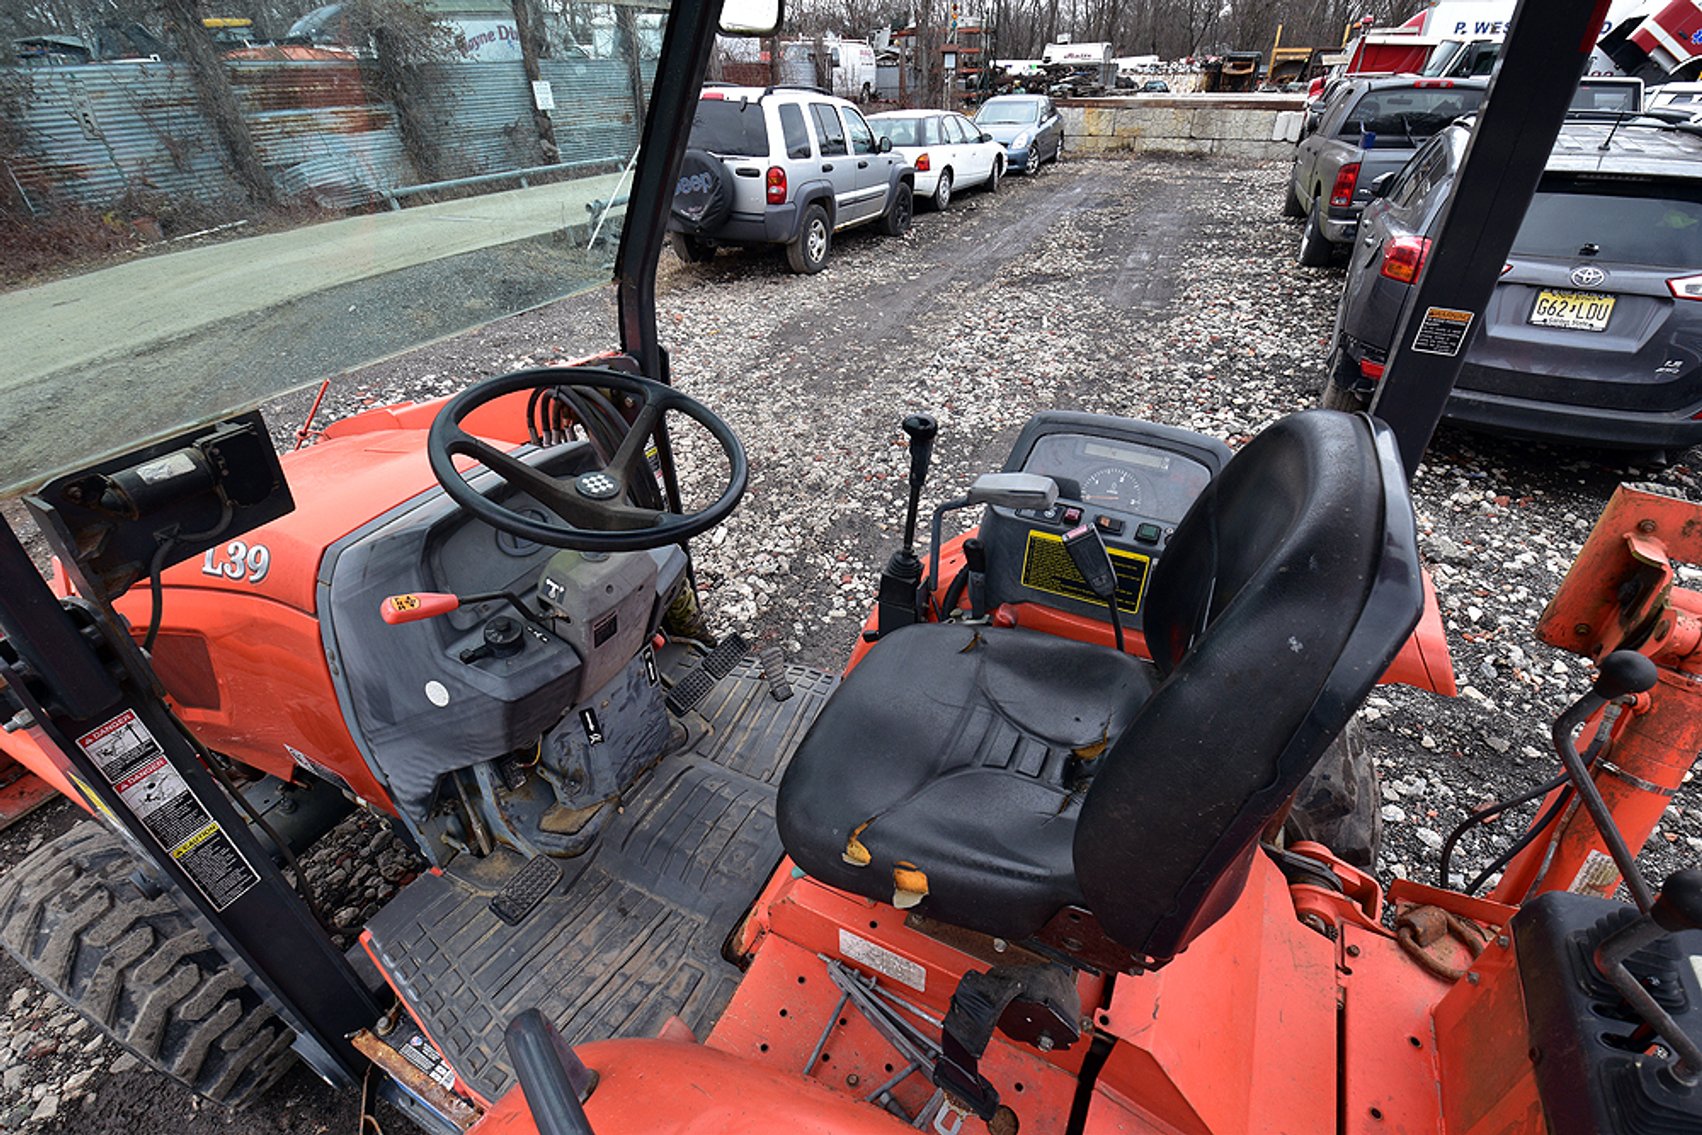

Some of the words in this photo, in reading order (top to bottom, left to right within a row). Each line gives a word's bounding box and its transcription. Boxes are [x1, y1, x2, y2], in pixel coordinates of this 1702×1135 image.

[1537, 298, 1568, 318] G62
[202, 541, 271, 585] L39
[92, 713, 132, 740] DANGER
[126, 757, 167, 784] DANGER
